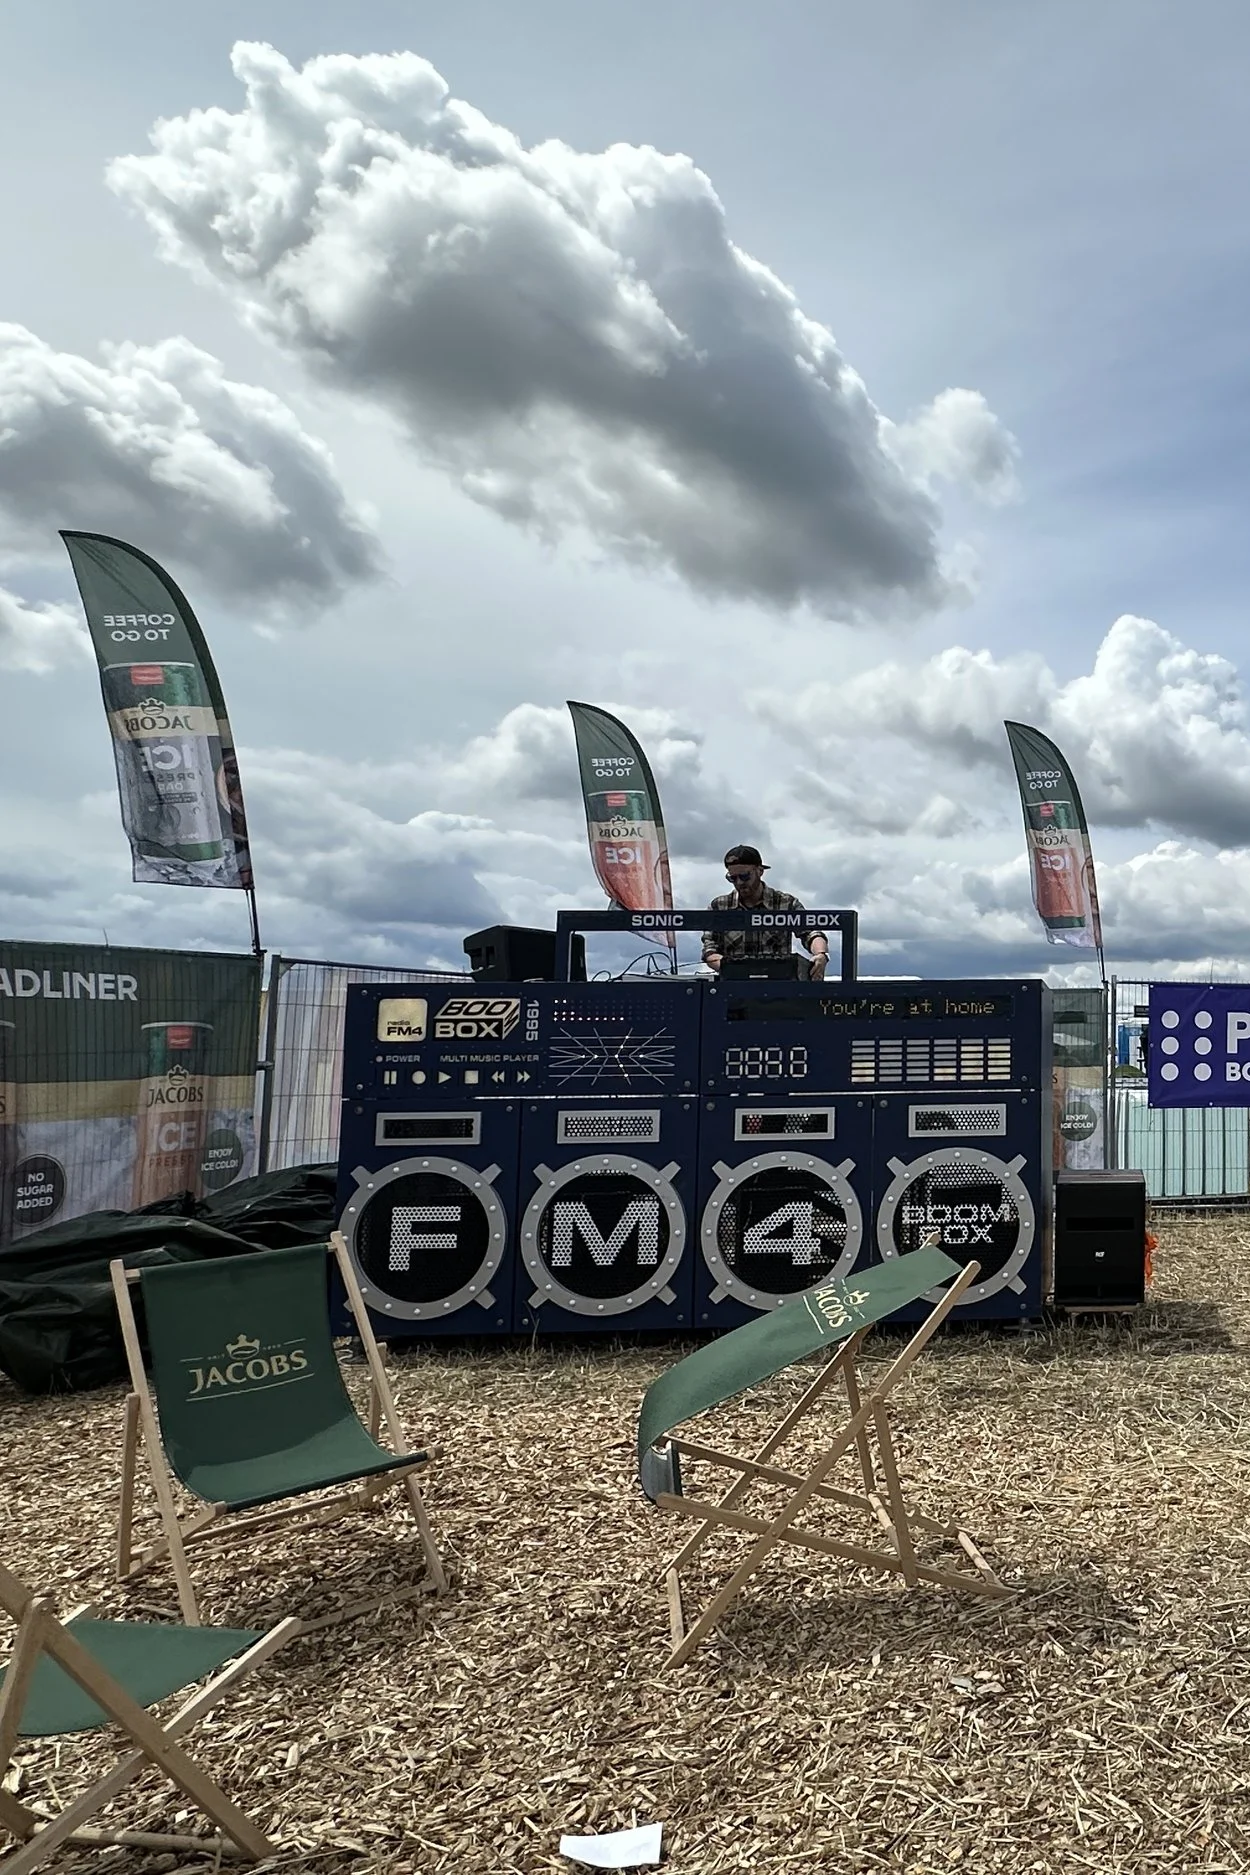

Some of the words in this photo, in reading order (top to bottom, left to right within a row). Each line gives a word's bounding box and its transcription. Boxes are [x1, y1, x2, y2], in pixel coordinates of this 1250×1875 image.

[631, 913, 684, 927] SONIC
[751, 913, 801, 927] BOOM
[806, 913, 840, 926] BOX
[820, 999, 894, 1016] You're
[910, 999, 932, 1015] at
[945, 999, 995, 1015] home
[526, 999, 540, 1041] 1995
[387, 1026, 423, 1036] FM4
[435, 1022, 499, 1038] BOX
[385, 1054, 421, 1063] POWER
[440, 1055, 468, 1063] MULTI
[470, 1054, 500, 1063] MUSIC
[503, 1054, 540, 1063] PLAYER
[147, 1086, 204, 1108] JACOBS
[208, 1147, 234, 1159] ENJOY
[201, 1162, 215, 1172] ICE
[215, 1159, 239, 1170] COLD!
[27, 1172, 45, 1183] NO
[16, 1183, 54, 1197] SUGAR
[16, 1196, 53, 1210] ADDED
[902, 1204, 1010, 1223] BOOM
[388, 1206, 461, 1271] F
[551, 1200, 660, 1267] M
[743, 1201, 821, 1266] 4
[188, 1349, 308, 1395] JACOBS
